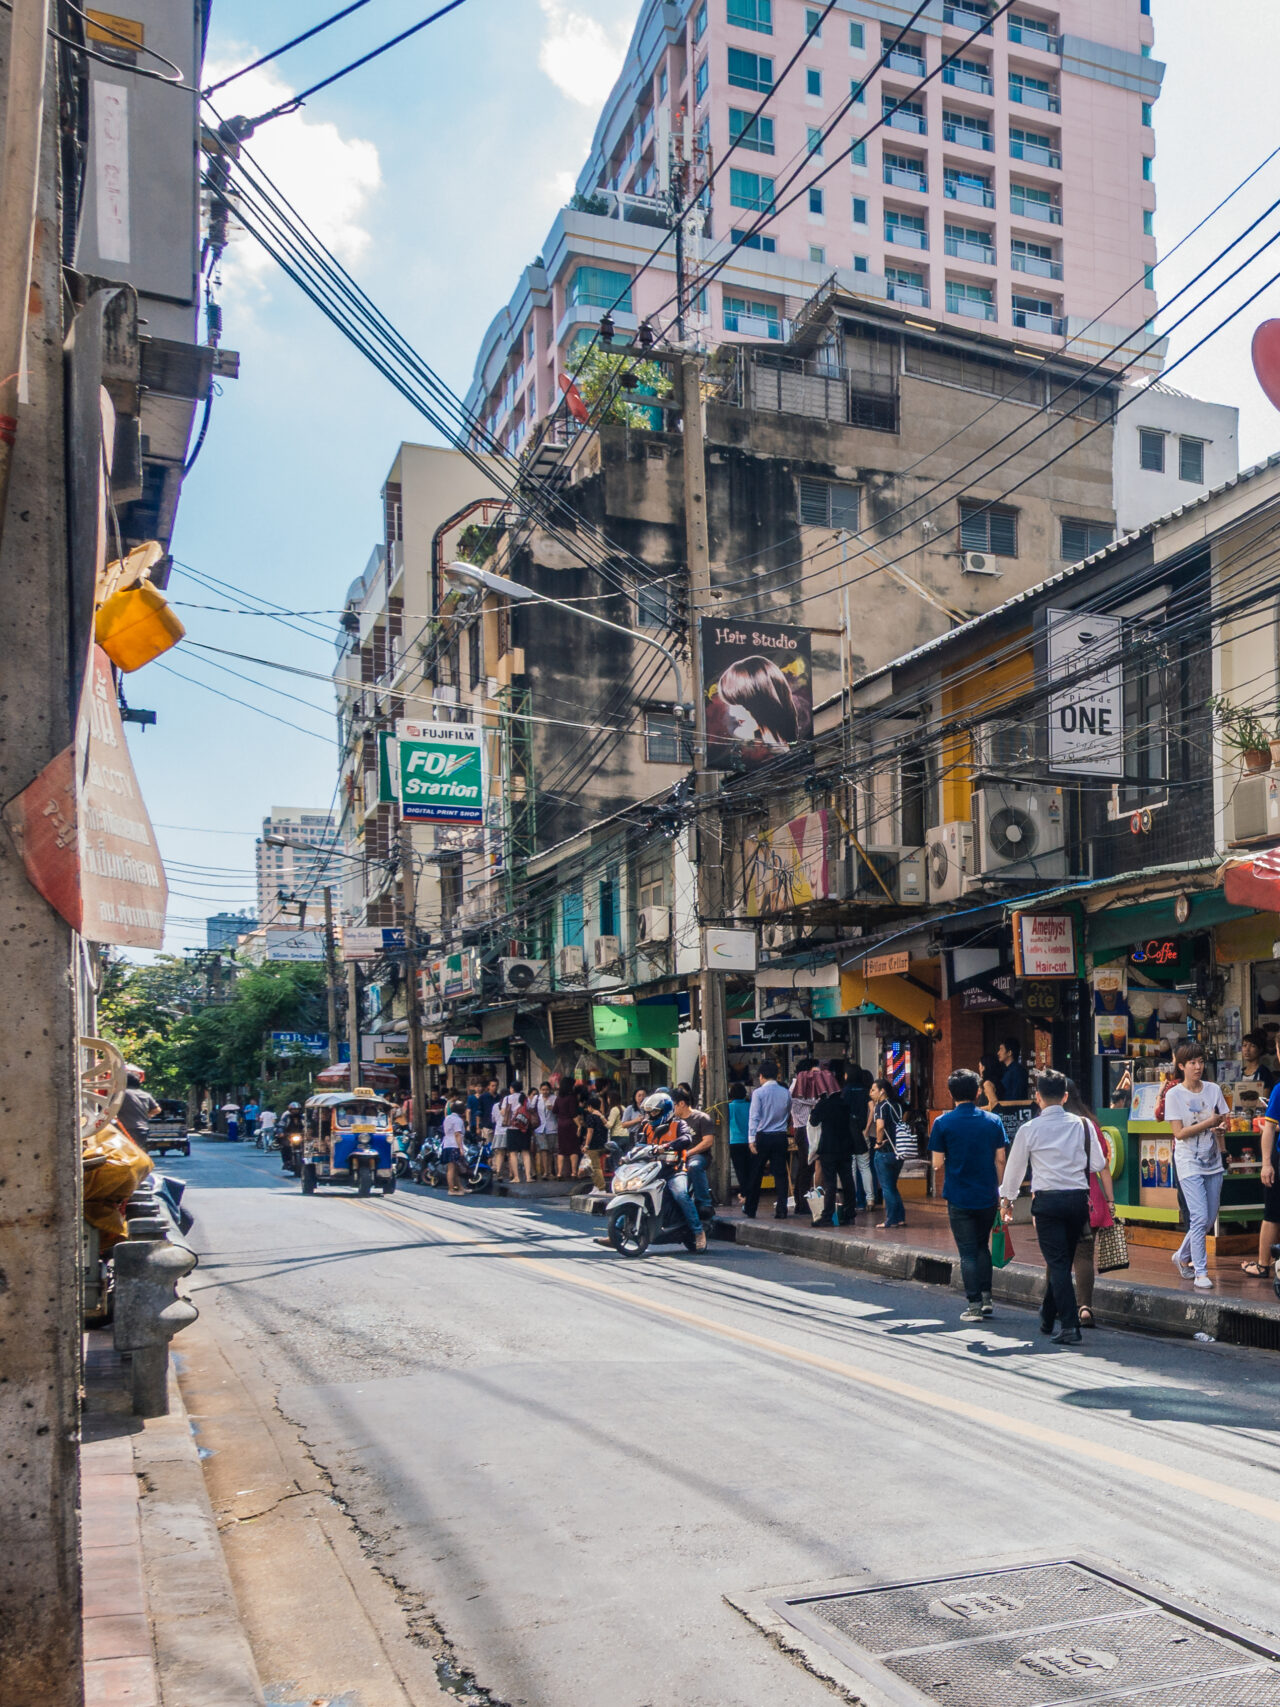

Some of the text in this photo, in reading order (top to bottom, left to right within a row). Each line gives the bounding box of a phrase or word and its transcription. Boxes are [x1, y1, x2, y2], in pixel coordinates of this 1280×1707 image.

[715, 629, 798, 650] Hair Studio
[1060, 705, 1113, 736] ONE
[423, 728, 474, 740] FUJIFILM
[405, 778, 479, 798] Station
[406, 807, 435, 815] DIGITAL
[1031, 916, 1066, 941] Amethyst
[1146, 940, 1178, 964] Coffee
[1035, 960, 1067, 972] Hair-cut
[992, 976, 1011, 990] ellar
